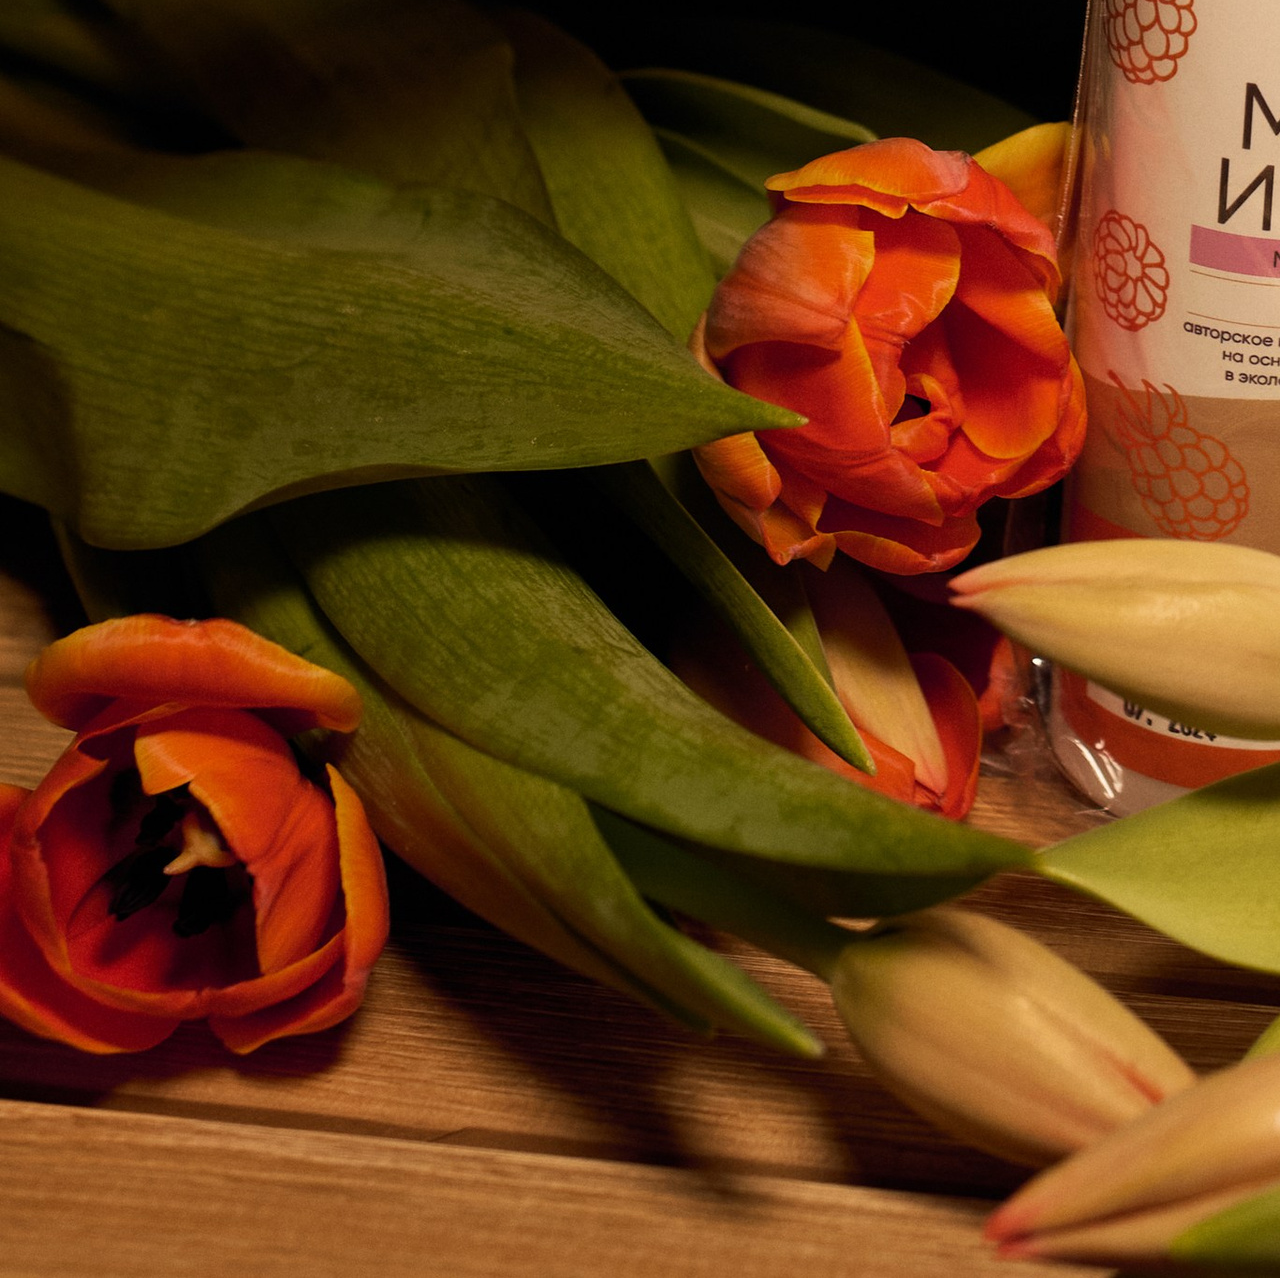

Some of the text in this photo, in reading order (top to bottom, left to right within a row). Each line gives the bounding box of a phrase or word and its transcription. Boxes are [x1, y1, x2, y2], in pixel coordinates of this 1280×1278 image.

[1216, 156, 1275, 232] И
[1182, 320, 1274, 348] авторское
[1222, 350, 1244, 364] на
[1224, 370, 1235, 381] в
